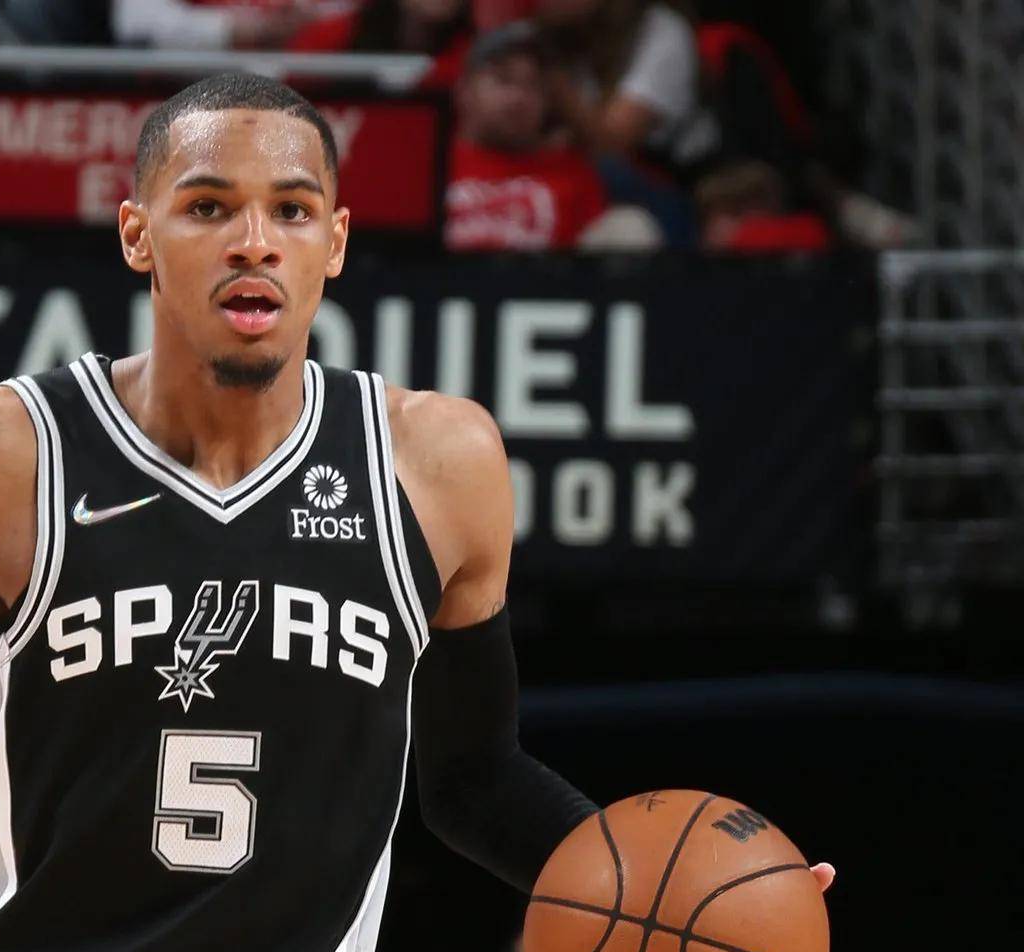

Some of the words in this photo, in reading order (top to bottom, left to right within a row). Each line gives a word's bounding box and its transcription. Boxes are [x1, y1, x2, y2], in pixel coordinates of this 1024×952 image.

[291, 509, 366, 540] Frost
[47, 580, 390, 712] SPURS
[151, 729, 261, 874] 5
